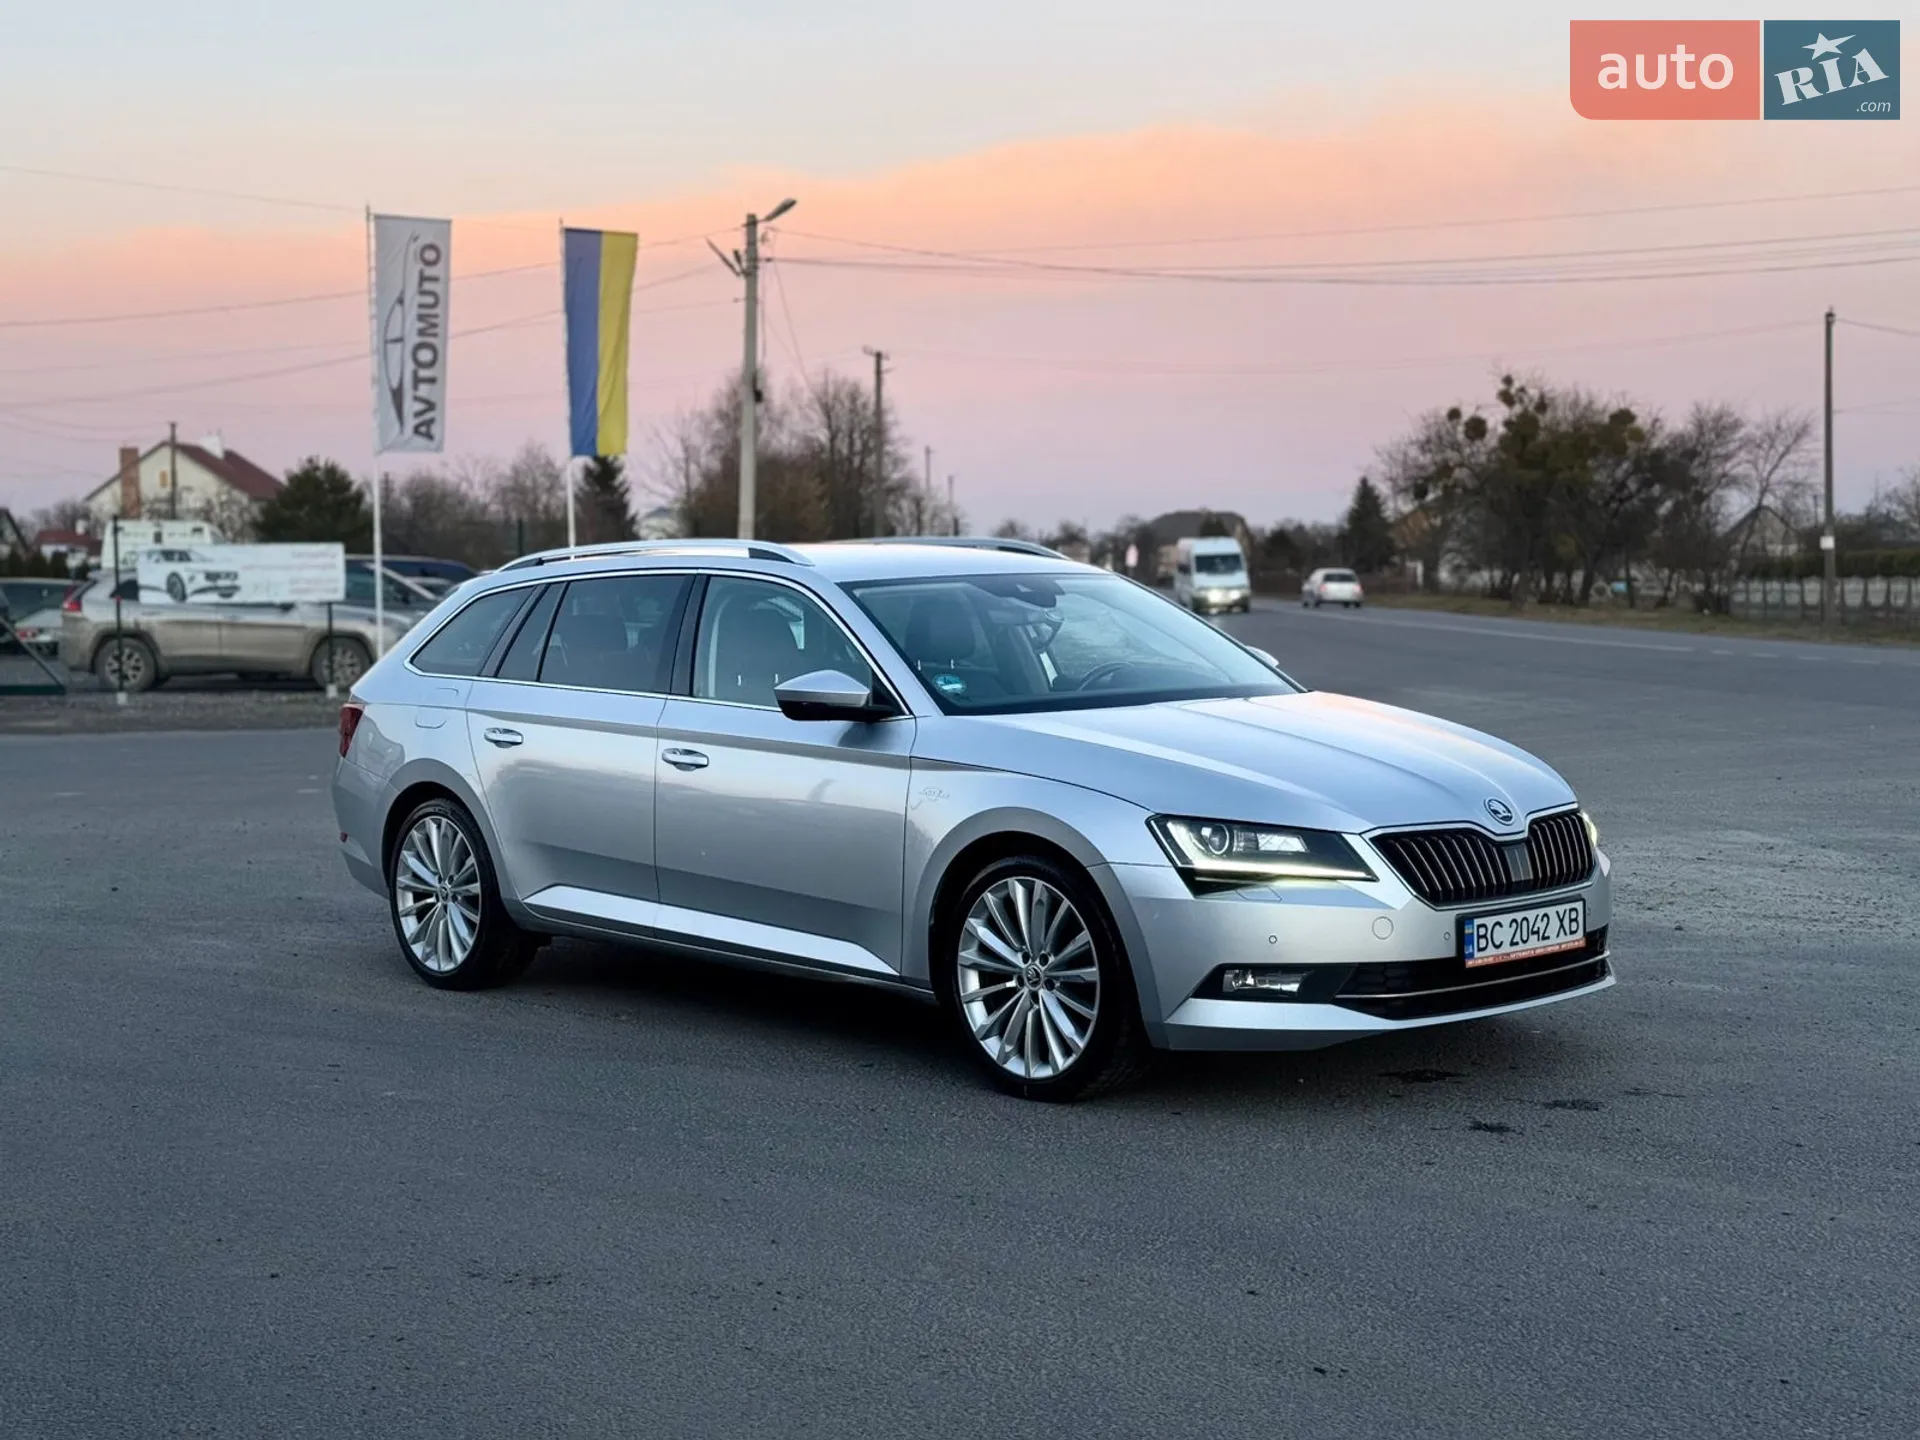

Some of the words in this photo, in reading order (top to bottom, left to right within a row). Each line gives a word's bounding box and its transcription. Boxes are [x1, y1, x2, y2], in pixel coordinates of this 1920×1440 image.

[411, 243, 442, 442] AVTOMUTO
[1476, 921, 1503, 952] BC
[1509, 912, 1550, 947] 2042
[1556, 907, 1580, 938] XB
